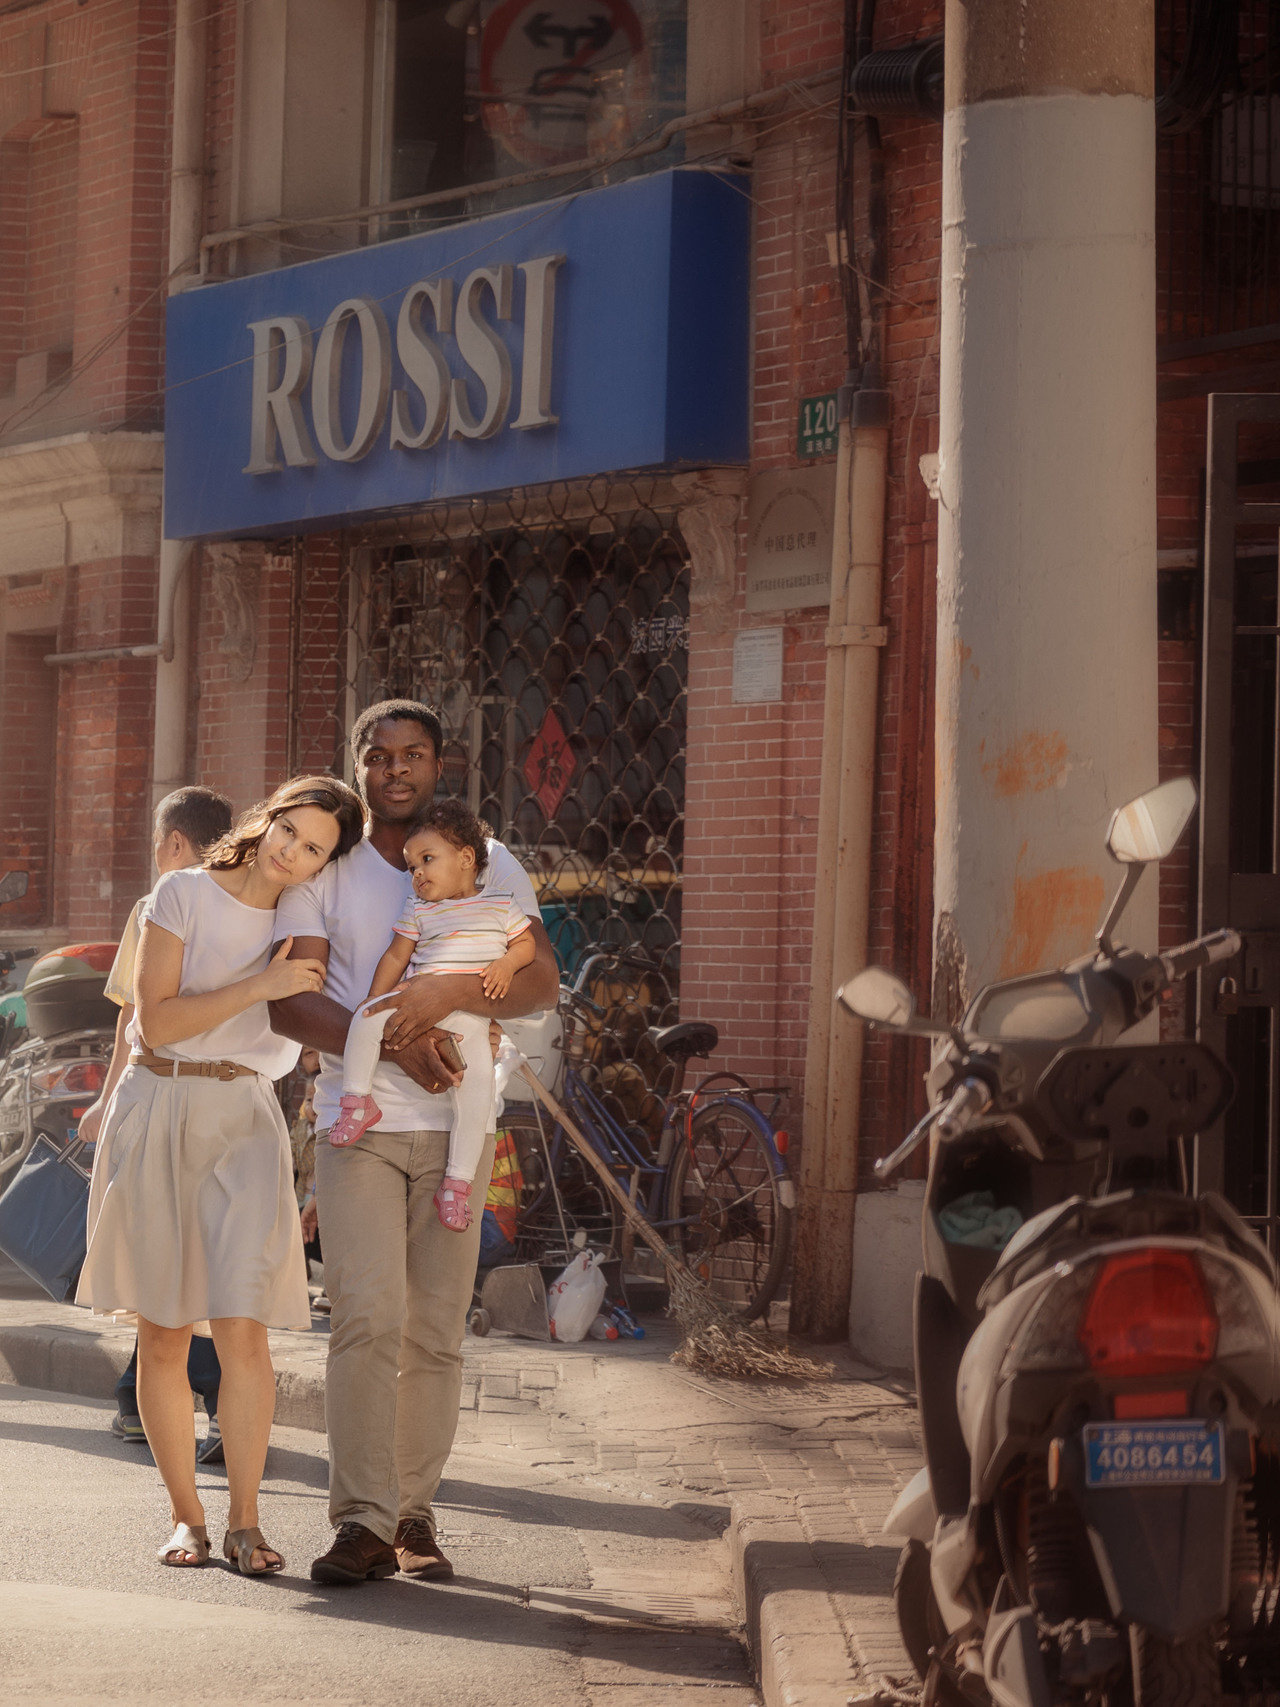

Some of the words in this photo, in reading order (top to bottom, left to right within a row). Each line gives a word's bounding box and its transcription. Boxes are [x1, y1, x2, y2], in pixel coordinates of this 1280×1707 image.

[242, 254, 567, 476] ROSSI
[803, 399, 836, 437] 120
[764, 531, 817, 554] 中国总代理
[1096, 1443, 1215, 1470] 4086454
